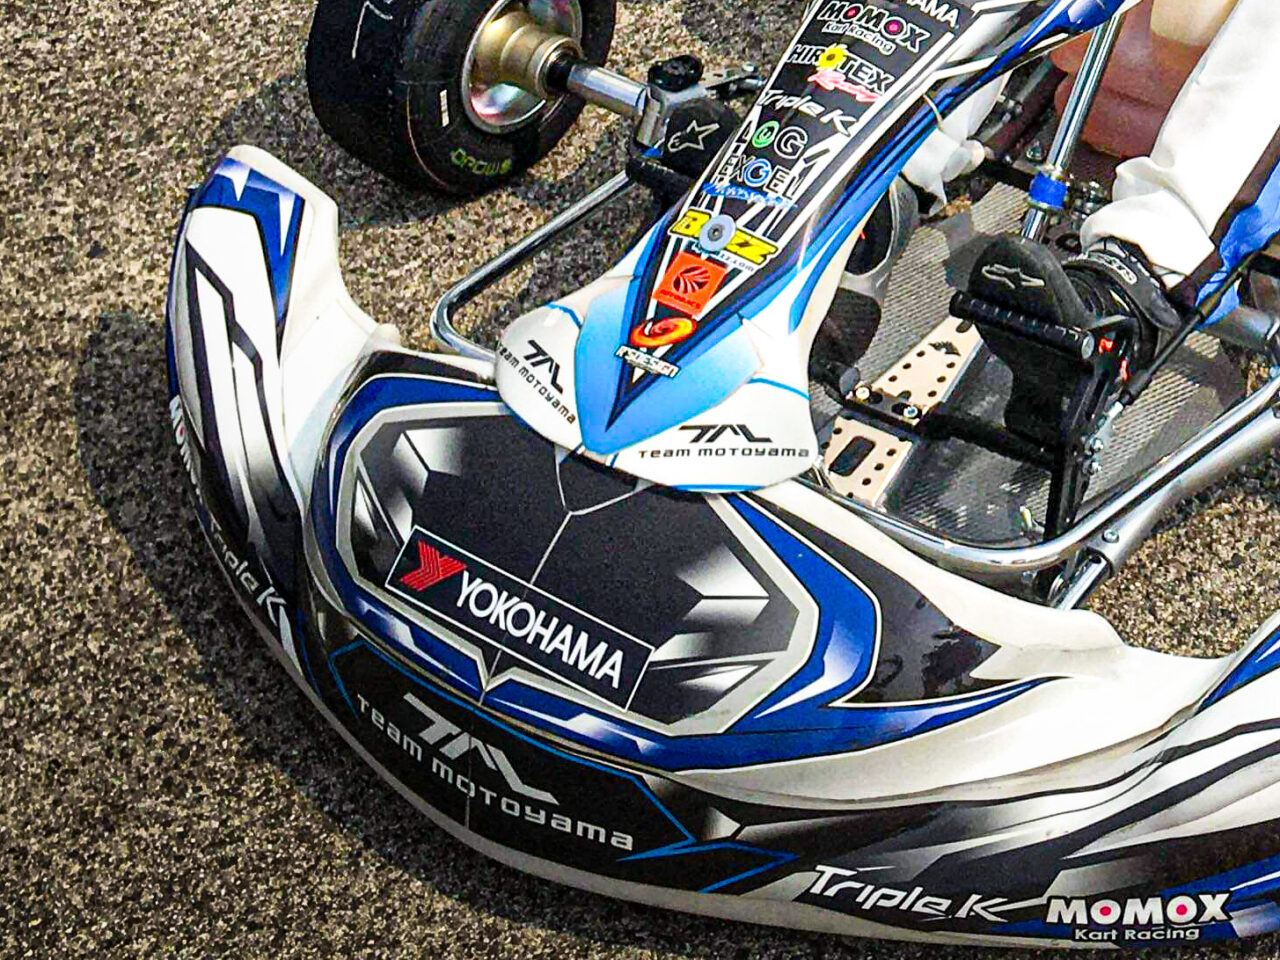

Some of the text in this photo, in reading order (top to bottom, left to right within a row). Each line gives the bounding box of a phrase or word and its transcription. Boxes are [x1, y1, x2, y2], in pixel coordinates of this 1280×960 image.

[817, 0, 931, 53] MOMOX
[822, 21, 897, 56] Kart Racing
[756, 89, 826, 118] Triple
[718, 154, 799, 201] EXGEL
[456, 570, 624, 689] YOKOHAMA
[809, 864, 1010, 923] Triple K
[1045, 891, 1231, 926] MOMOX
[1074, 926, 1200, 941] Kart Racing
